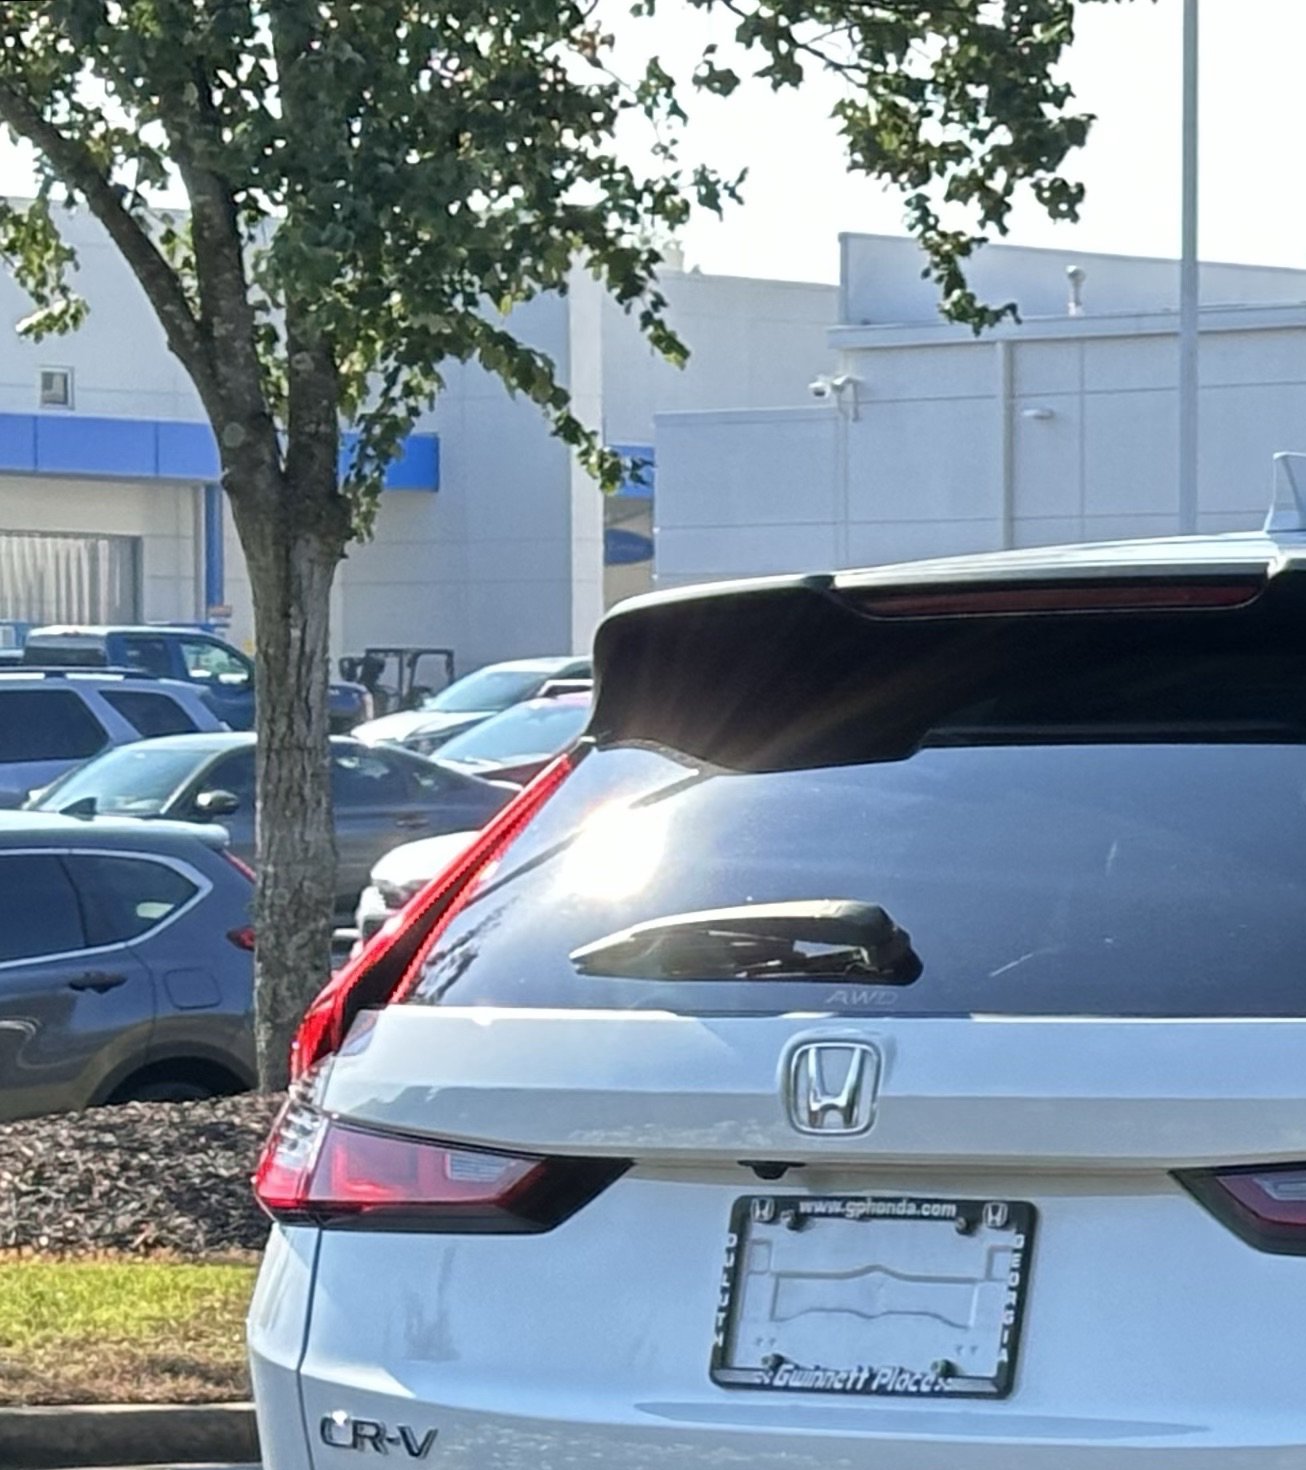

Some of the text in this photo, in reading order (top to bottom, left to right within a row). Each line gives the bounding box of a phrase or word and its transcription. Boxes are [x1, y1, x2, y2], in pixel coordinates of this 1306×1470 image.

[825, 989, 899, 1006] AWD
[799, 1199, 957, 1218] www.gphonda.com
[772, 1364, 934, 1392] Gwinnett Place
[319, 1411, 439, 1460] CR-V
